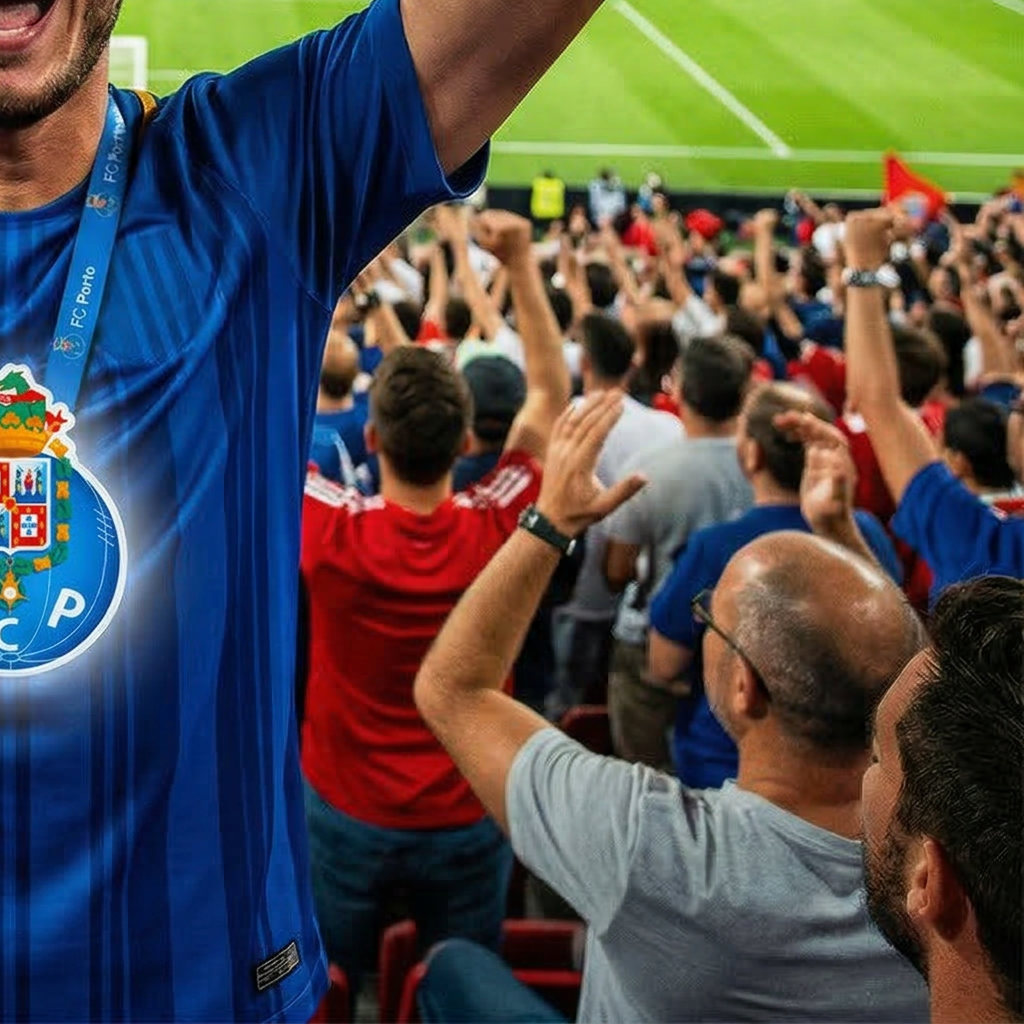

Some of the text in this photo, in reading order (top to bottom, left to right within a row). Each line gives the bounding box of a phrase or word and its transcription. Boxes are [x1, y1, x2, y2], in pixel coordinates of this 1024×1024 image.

[103, 163, 119, 183] FC
[70, 266, 96, 328] FC Porto
